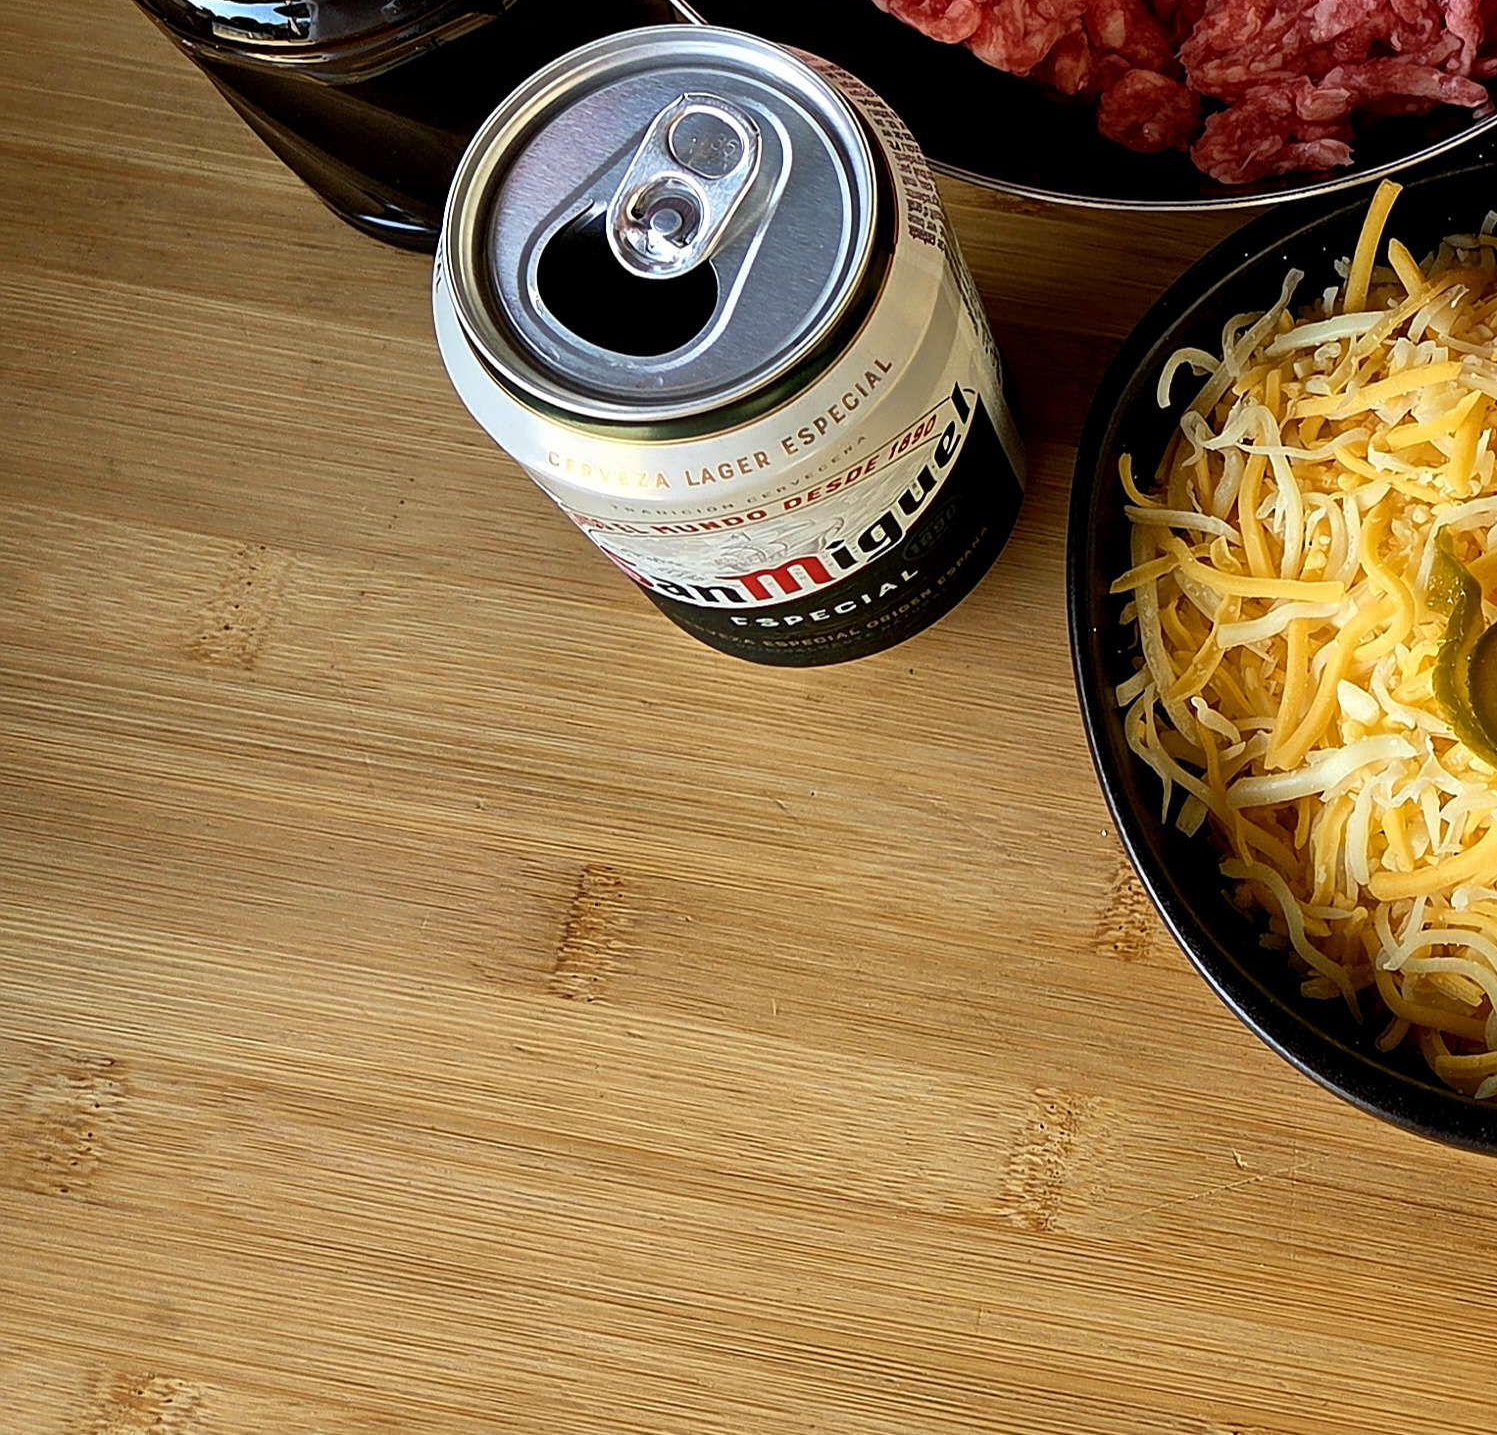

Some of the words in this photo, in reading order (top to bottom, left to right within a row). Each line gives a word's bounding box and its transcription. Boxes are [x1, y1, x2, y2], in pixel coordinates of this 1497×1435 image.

[548, 451, 671, 489] CERVEZA
[684, 451, 771, 487] LAGER
[781, 358, 893, 457] ESPECIAL
[649, 509, 768, 535] MUNDO
[783, 455, 880, 511] DESDE
[888, 414, 938, 461] 1890
[746, 436, 867, 504] CERVECERA
[730, 568, 919, 628] ESPECIAL
[762, 628, 861, 649] ESPECIAL
[866, 587, 933, 629] ORIGEN
